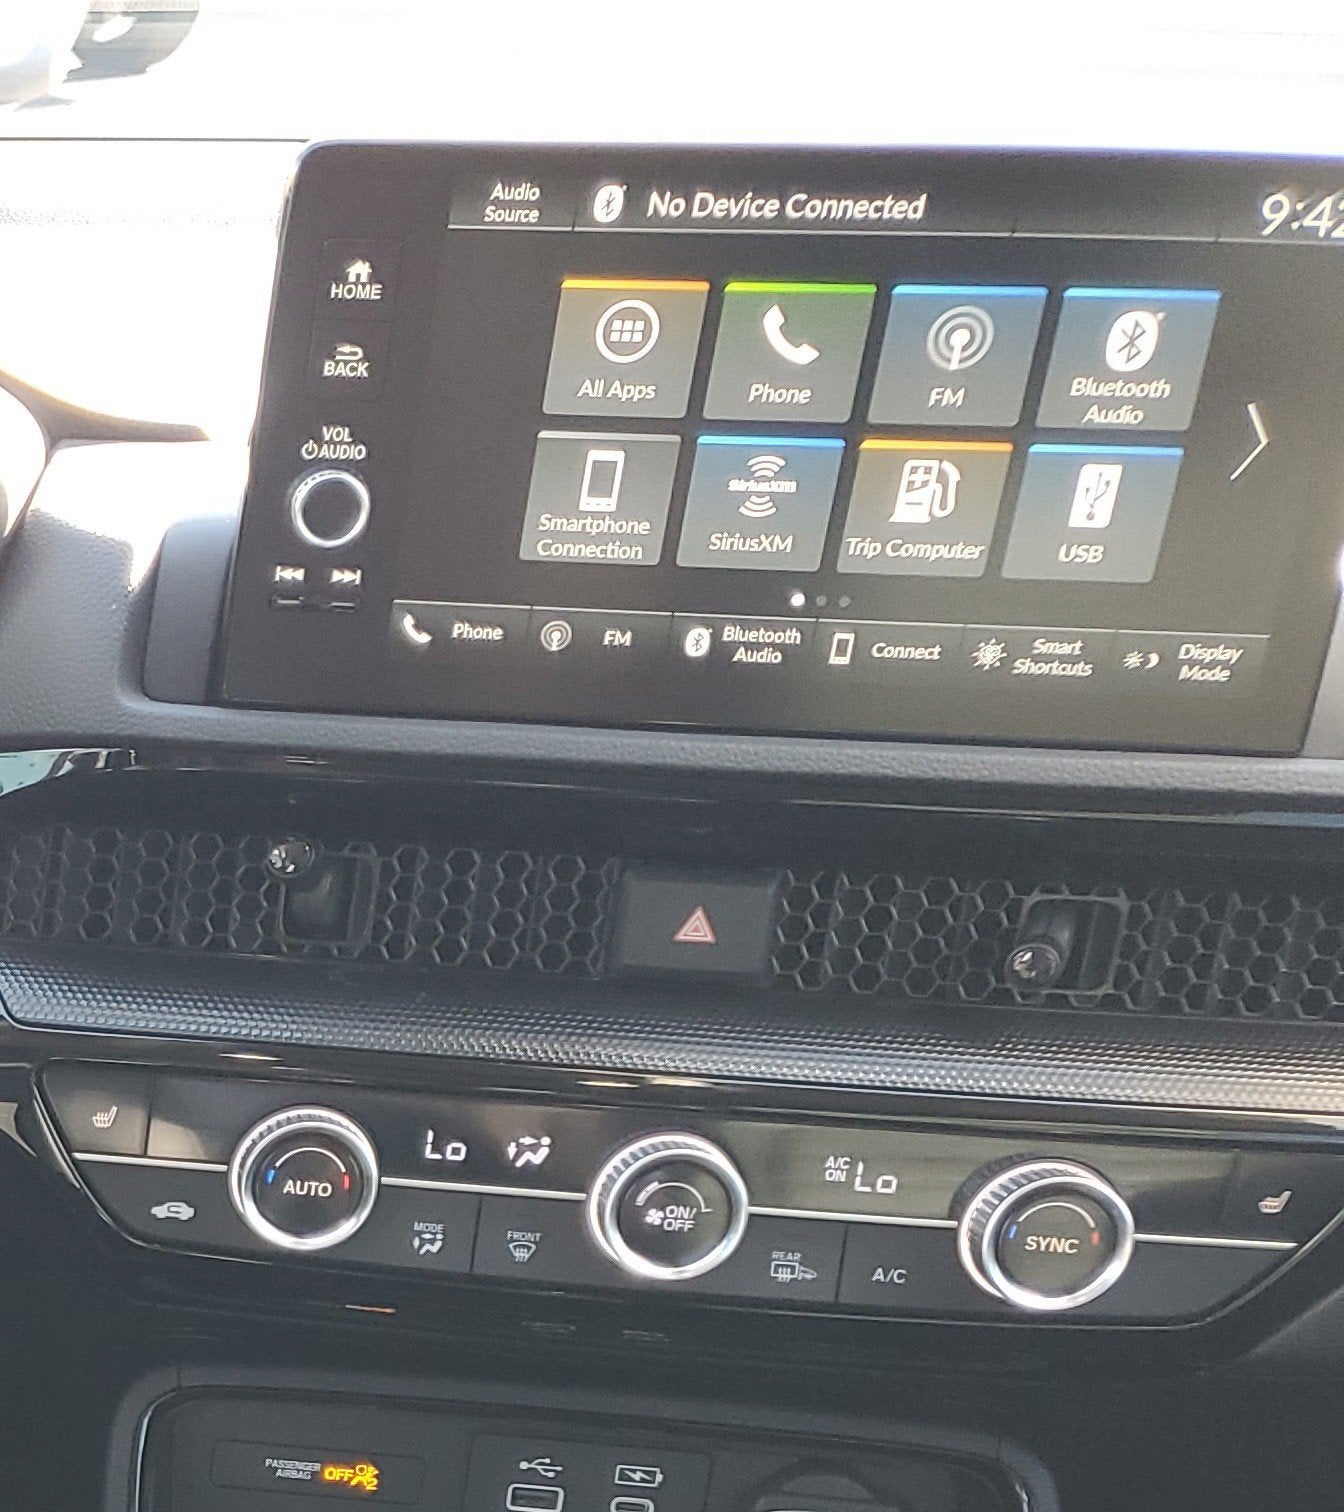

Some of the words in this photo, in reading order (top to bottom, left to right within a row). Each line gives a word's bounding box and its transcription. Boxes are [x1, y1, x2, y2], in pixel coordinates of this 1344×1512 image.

[490, 183, 540, 202] Audio
[483, 205, 540, 223] Source
[647, 192, 684, 219] No
[690, 192, 780, 219] Device
[785, 194, 927, 220] Connected
[330, 284, 382, 300] HOME
[323, 361, 369, 378] BACK
[577, 379, 606, 399] All
[610, 381, 656, 401] Apps
[748, 383, 812, 404] Phone
[1070, 378, 1171, 399] Bluetooth
[928, 388, 965, 408] FM
[1082, 404, 1144, 425] Audio
[322, 427, 353, 443] VOL
[319, 444, 367, 460] AUDIO
[537, 514, 651, 537] Smartphone
[536, 541, 643, 559] Connection
[708, 532, 793, 553] SiriusXM
[845, 537, 882, 558] Trip
[885, 539, 985, 560] Computer
[1058, 544, 1104, 564] USB
[452, 623, 504, 641] Phone
[603, 630, 632, 648] FM
[721, 625, 801, 645] Bluetooth
[732, 647, 783, 664] Audio
[872, 642, 941, 661] Connect
[1032, 639, 1082, 656] Smart
[1178, 644, 1243, 665] Display
[1013, 659, 1093, 678] Shortcuts
[1179, 664, 1232, 682] Mode
[425, 1129, 466, 1162] Lo
[825, 1156, 850, 1170] A/C
[825, 1168, 846, 1182] ON
[854, 1161, 898, 1195] Lo
[283, 1180, 332, 1198] AUTO
[665, 1205, 697, 1219] ON/
[414, 1221, 444, 1234] MODE
[663, 1217, 695, 1232] OFF
[507, 1230, 542, 1243] FRONT
[1024, 1235, 1079, 1255] SYNC
[772, 1251, 801, 1262] REAR
[872, 1266, 907, 1286] A/C
[276, 1469, 312, 1479] AIRBAG
[324, 1467, 354, 1481] OFF
